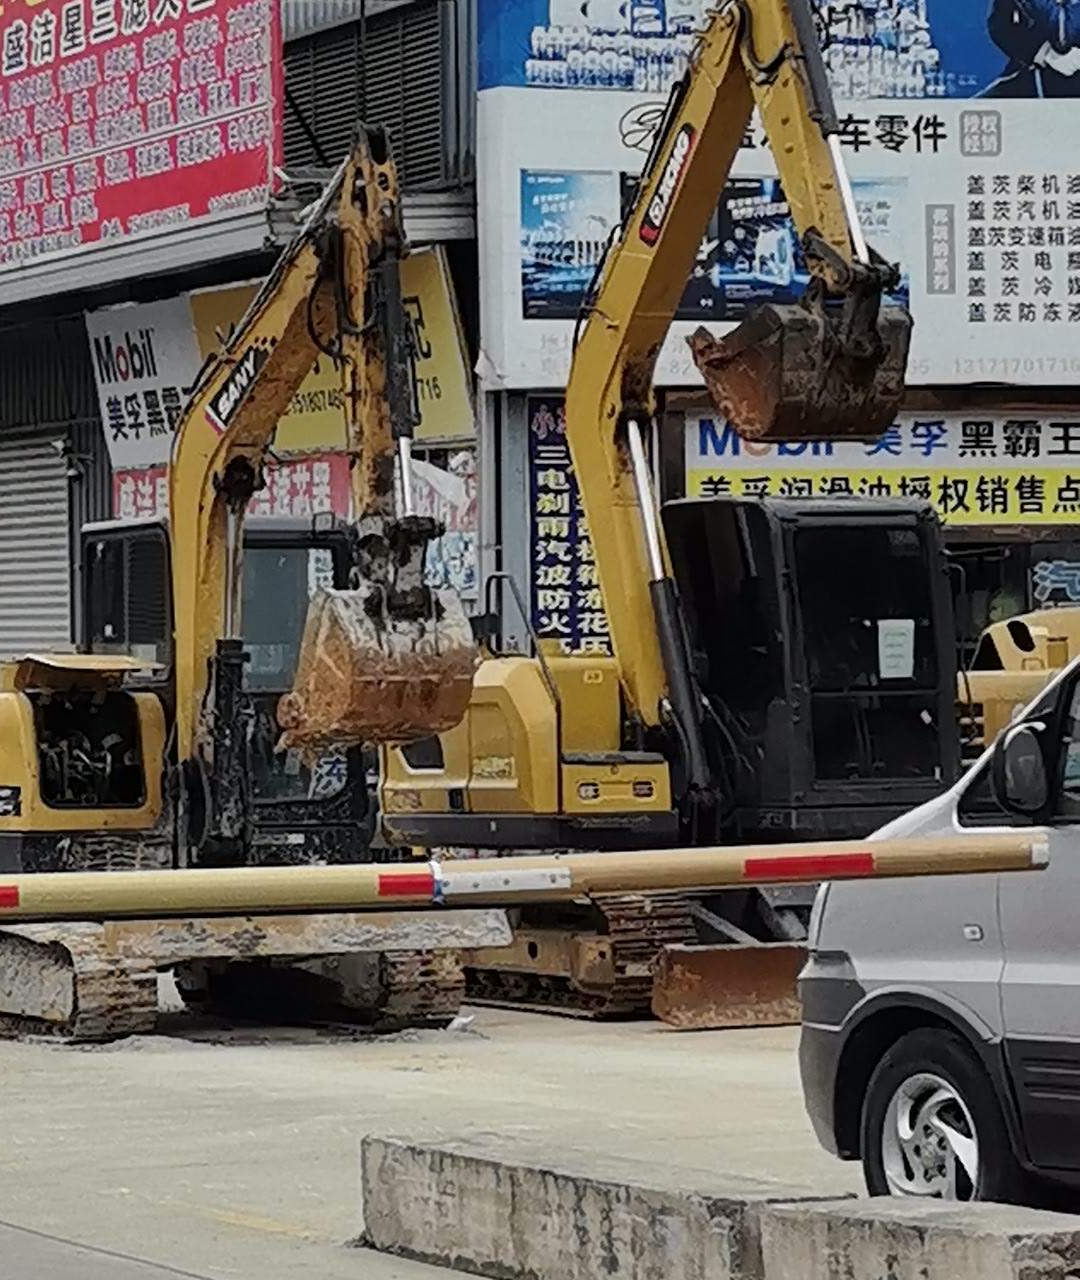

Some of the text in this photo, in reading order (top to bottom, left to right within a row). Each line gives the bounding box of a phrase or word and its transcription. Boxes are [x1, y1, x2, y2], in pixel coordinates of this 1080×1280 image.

[94, 328, 157, 384] Mobil
[218, 350, 255, 420] SANY
[106, 386, 191, 442] 美孚黑霸
